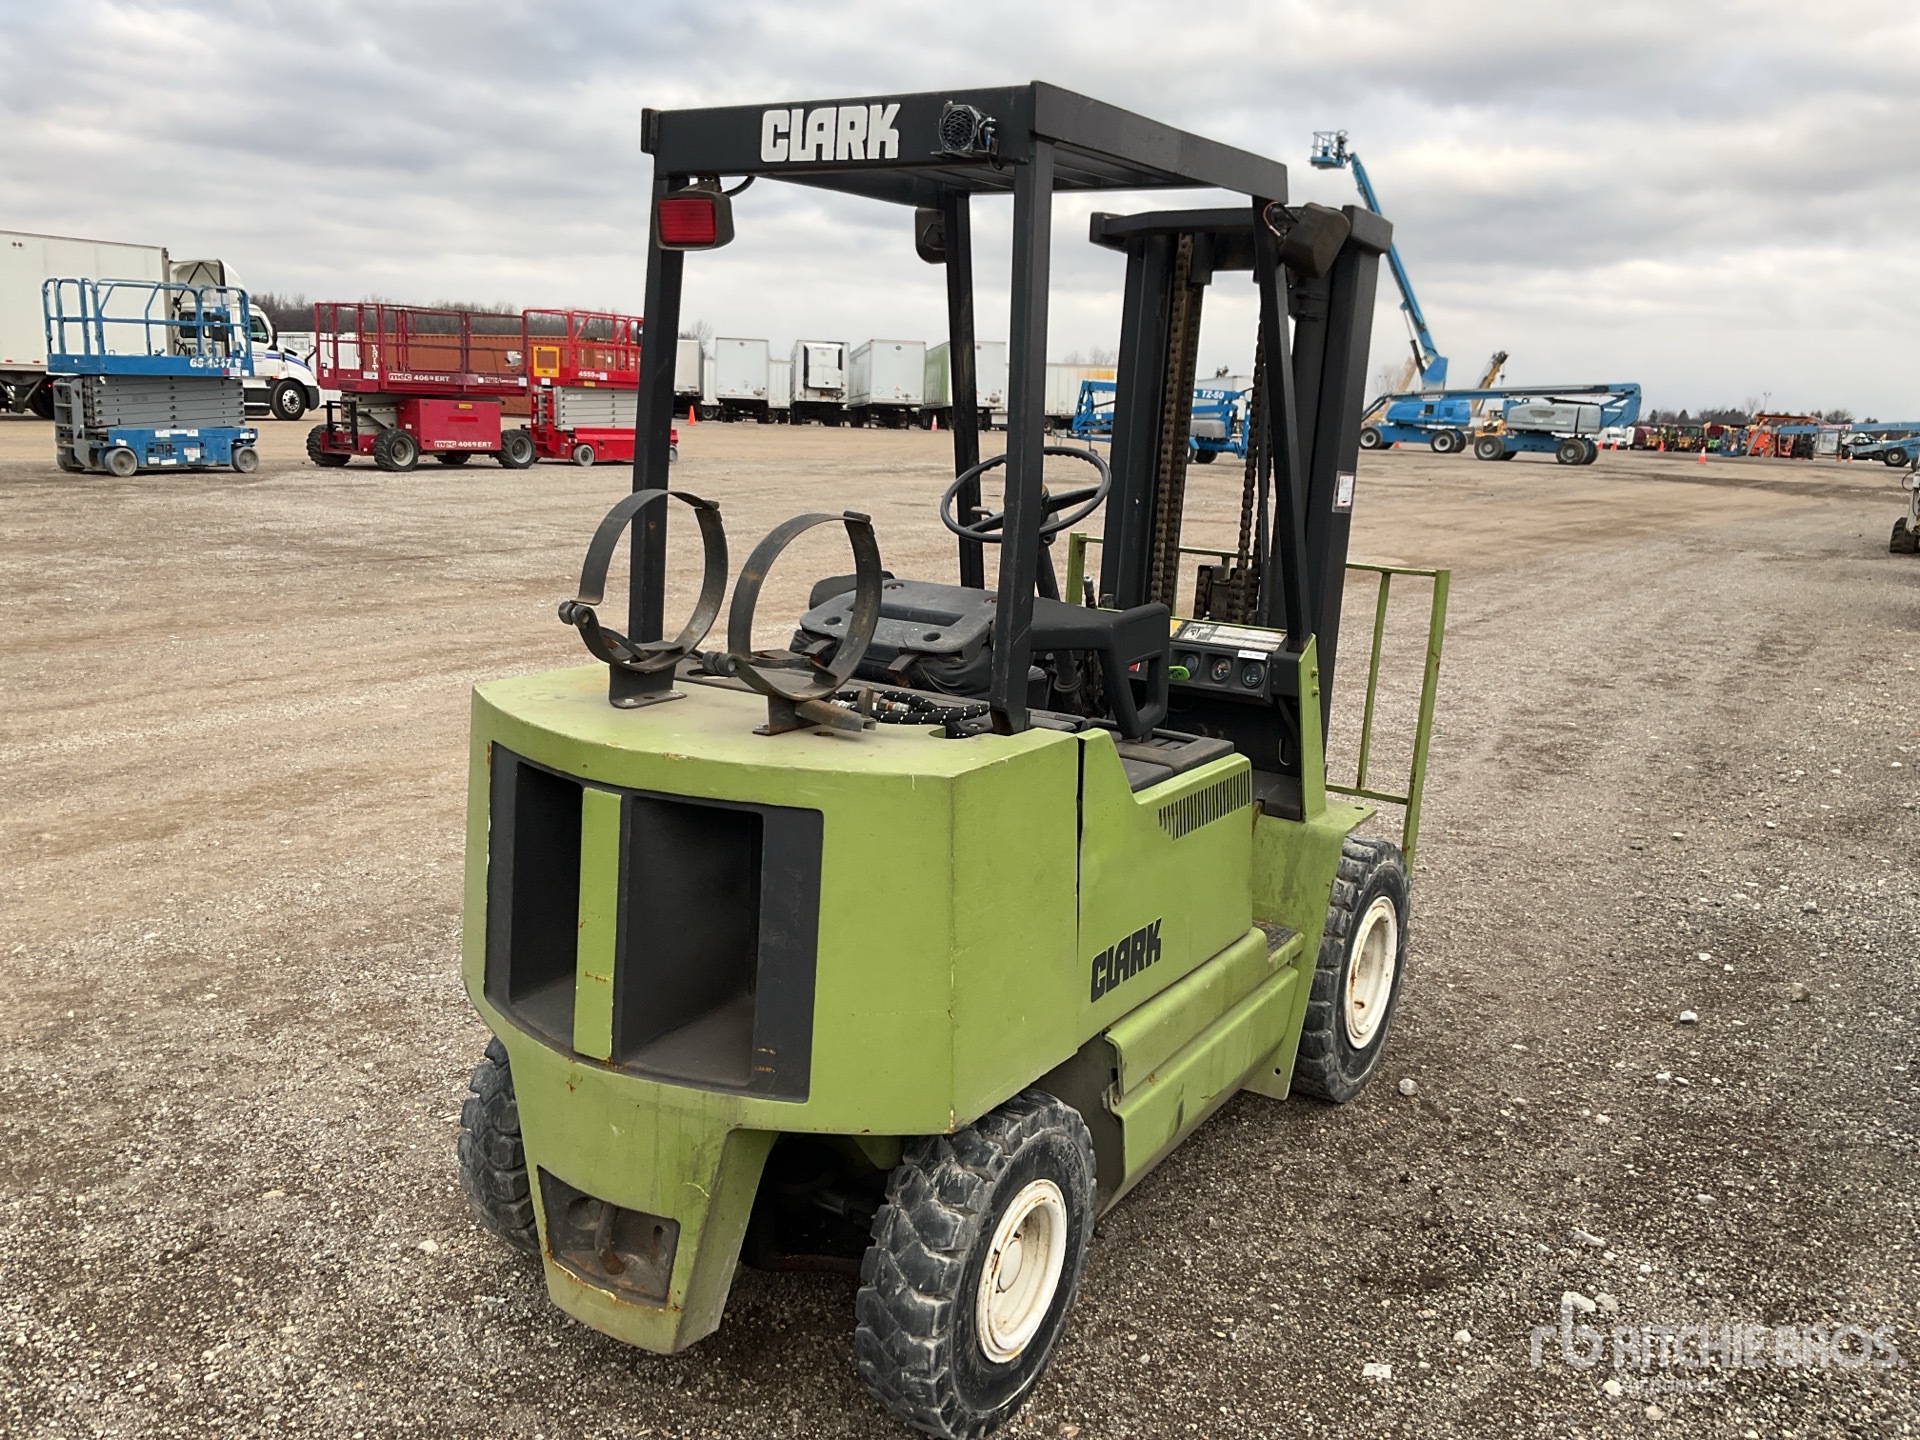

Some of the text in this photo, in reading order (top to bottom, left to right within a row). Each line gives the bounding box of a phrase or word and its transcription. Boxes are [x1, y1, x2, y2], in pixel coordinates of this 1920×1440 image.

[761, 103, 900, 162] CLARK
[1202, 390, 1225, 400] TZ-50
[1090, 917, 1162, 1003] CLARK
